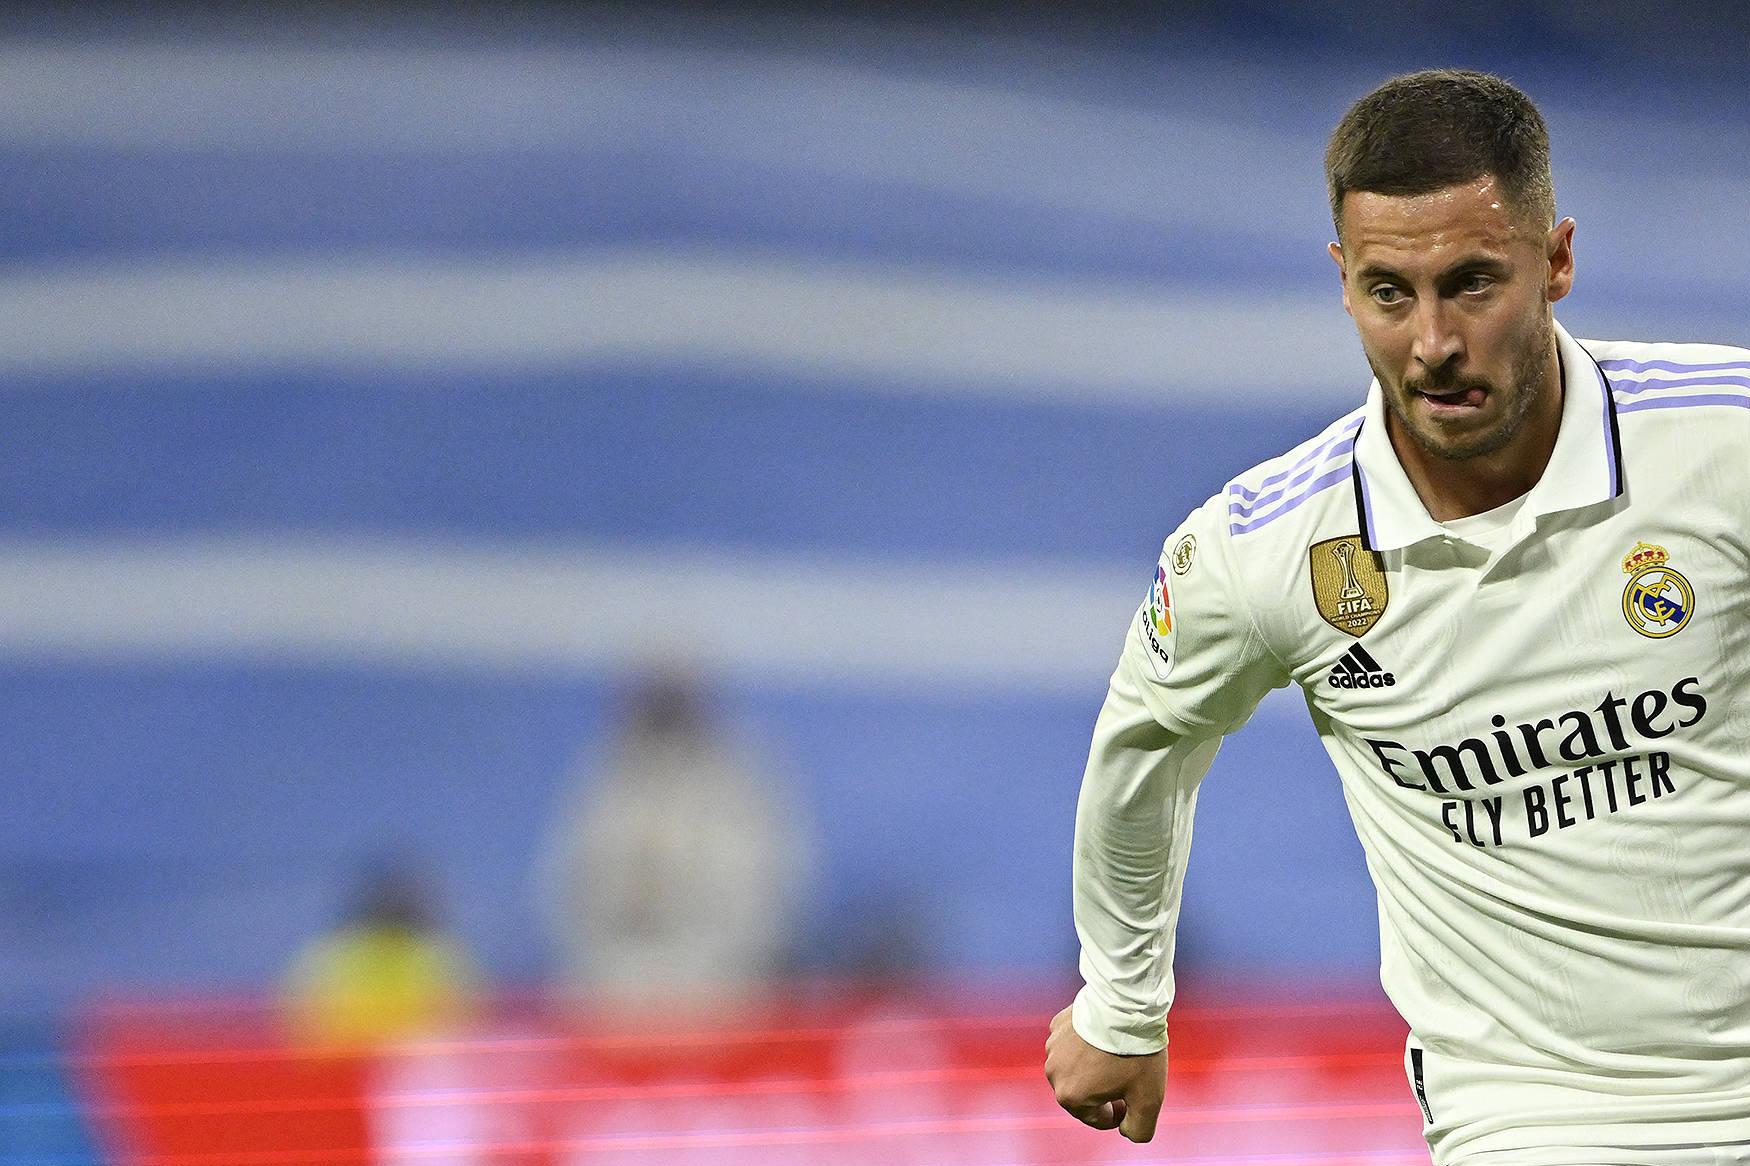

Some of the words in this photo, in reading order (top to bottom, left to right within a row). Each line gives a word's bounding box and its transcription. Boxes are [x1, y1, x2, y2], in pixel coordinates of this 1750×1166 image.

[1337, 598, 1372, 615] FIFA
[1347, 618, 1368, 628] 2022
[1142, 610, 1169, 664] aLiga
[1328, 671, 1396, 690] adidas
[1364, 676, 1708, 794] Emirates
[1441, 795, 1503, 848] FLY
[1522, 751, 1677, 839] BETTER
